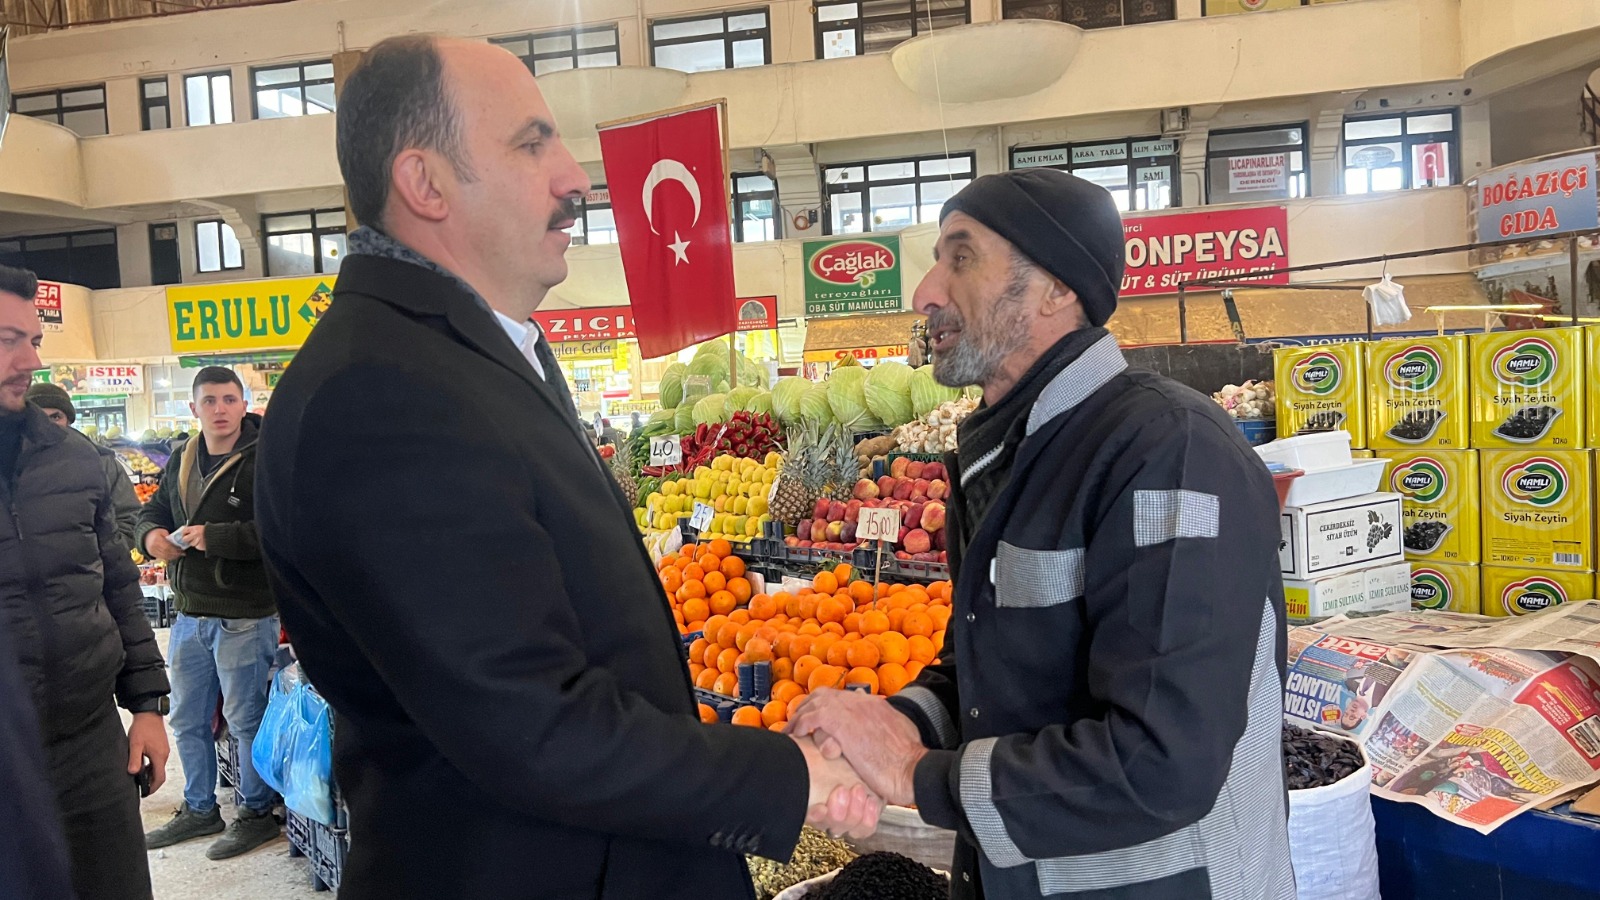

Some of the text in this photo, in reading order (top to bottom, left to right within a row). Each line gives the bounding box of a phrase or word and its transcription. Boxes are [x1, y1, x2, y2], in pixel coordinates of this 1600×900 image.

[1074, 148, 1125, 159] ARSA TARLA
[1133, 144, 1173, 153] ALIM SATIM
[1038, 153, 1064, 163] EMLAK
[1500, 206, 1559, 237] GIDA
[820, 250, 889, 276] Çağlak
[1144, 275, 1156, 288] &
[809, 297, 899, 313] OBA SÜT MAMÜLLERİ
[174, 294, 291, 341] ERULU
[1509, 359, 1540, 368] NAMLI
[1304, 370, 1329, 379] NAMLI
[1399, 365, 1427, 374] NAMLI
[1386, 398, 1441, 409] Siyah Zeytin
[1493, 394, 1556, 405] Siyah Zeytin
[1293, 401, 1342, 411] Siyah Zeytin
[653, 440, 673, 457] 40
[1519, 478, 1549, 486] NAMLI
[1417, 509, 1447, 521] Zeytin
[1503, 512, 1568, 524] Siyah Zeytin
[1519, 596, 1549, 605] NAMLI
[1320, 636, 1387, 656] akit
[1286, 671, 1342, 705] YALANCI
